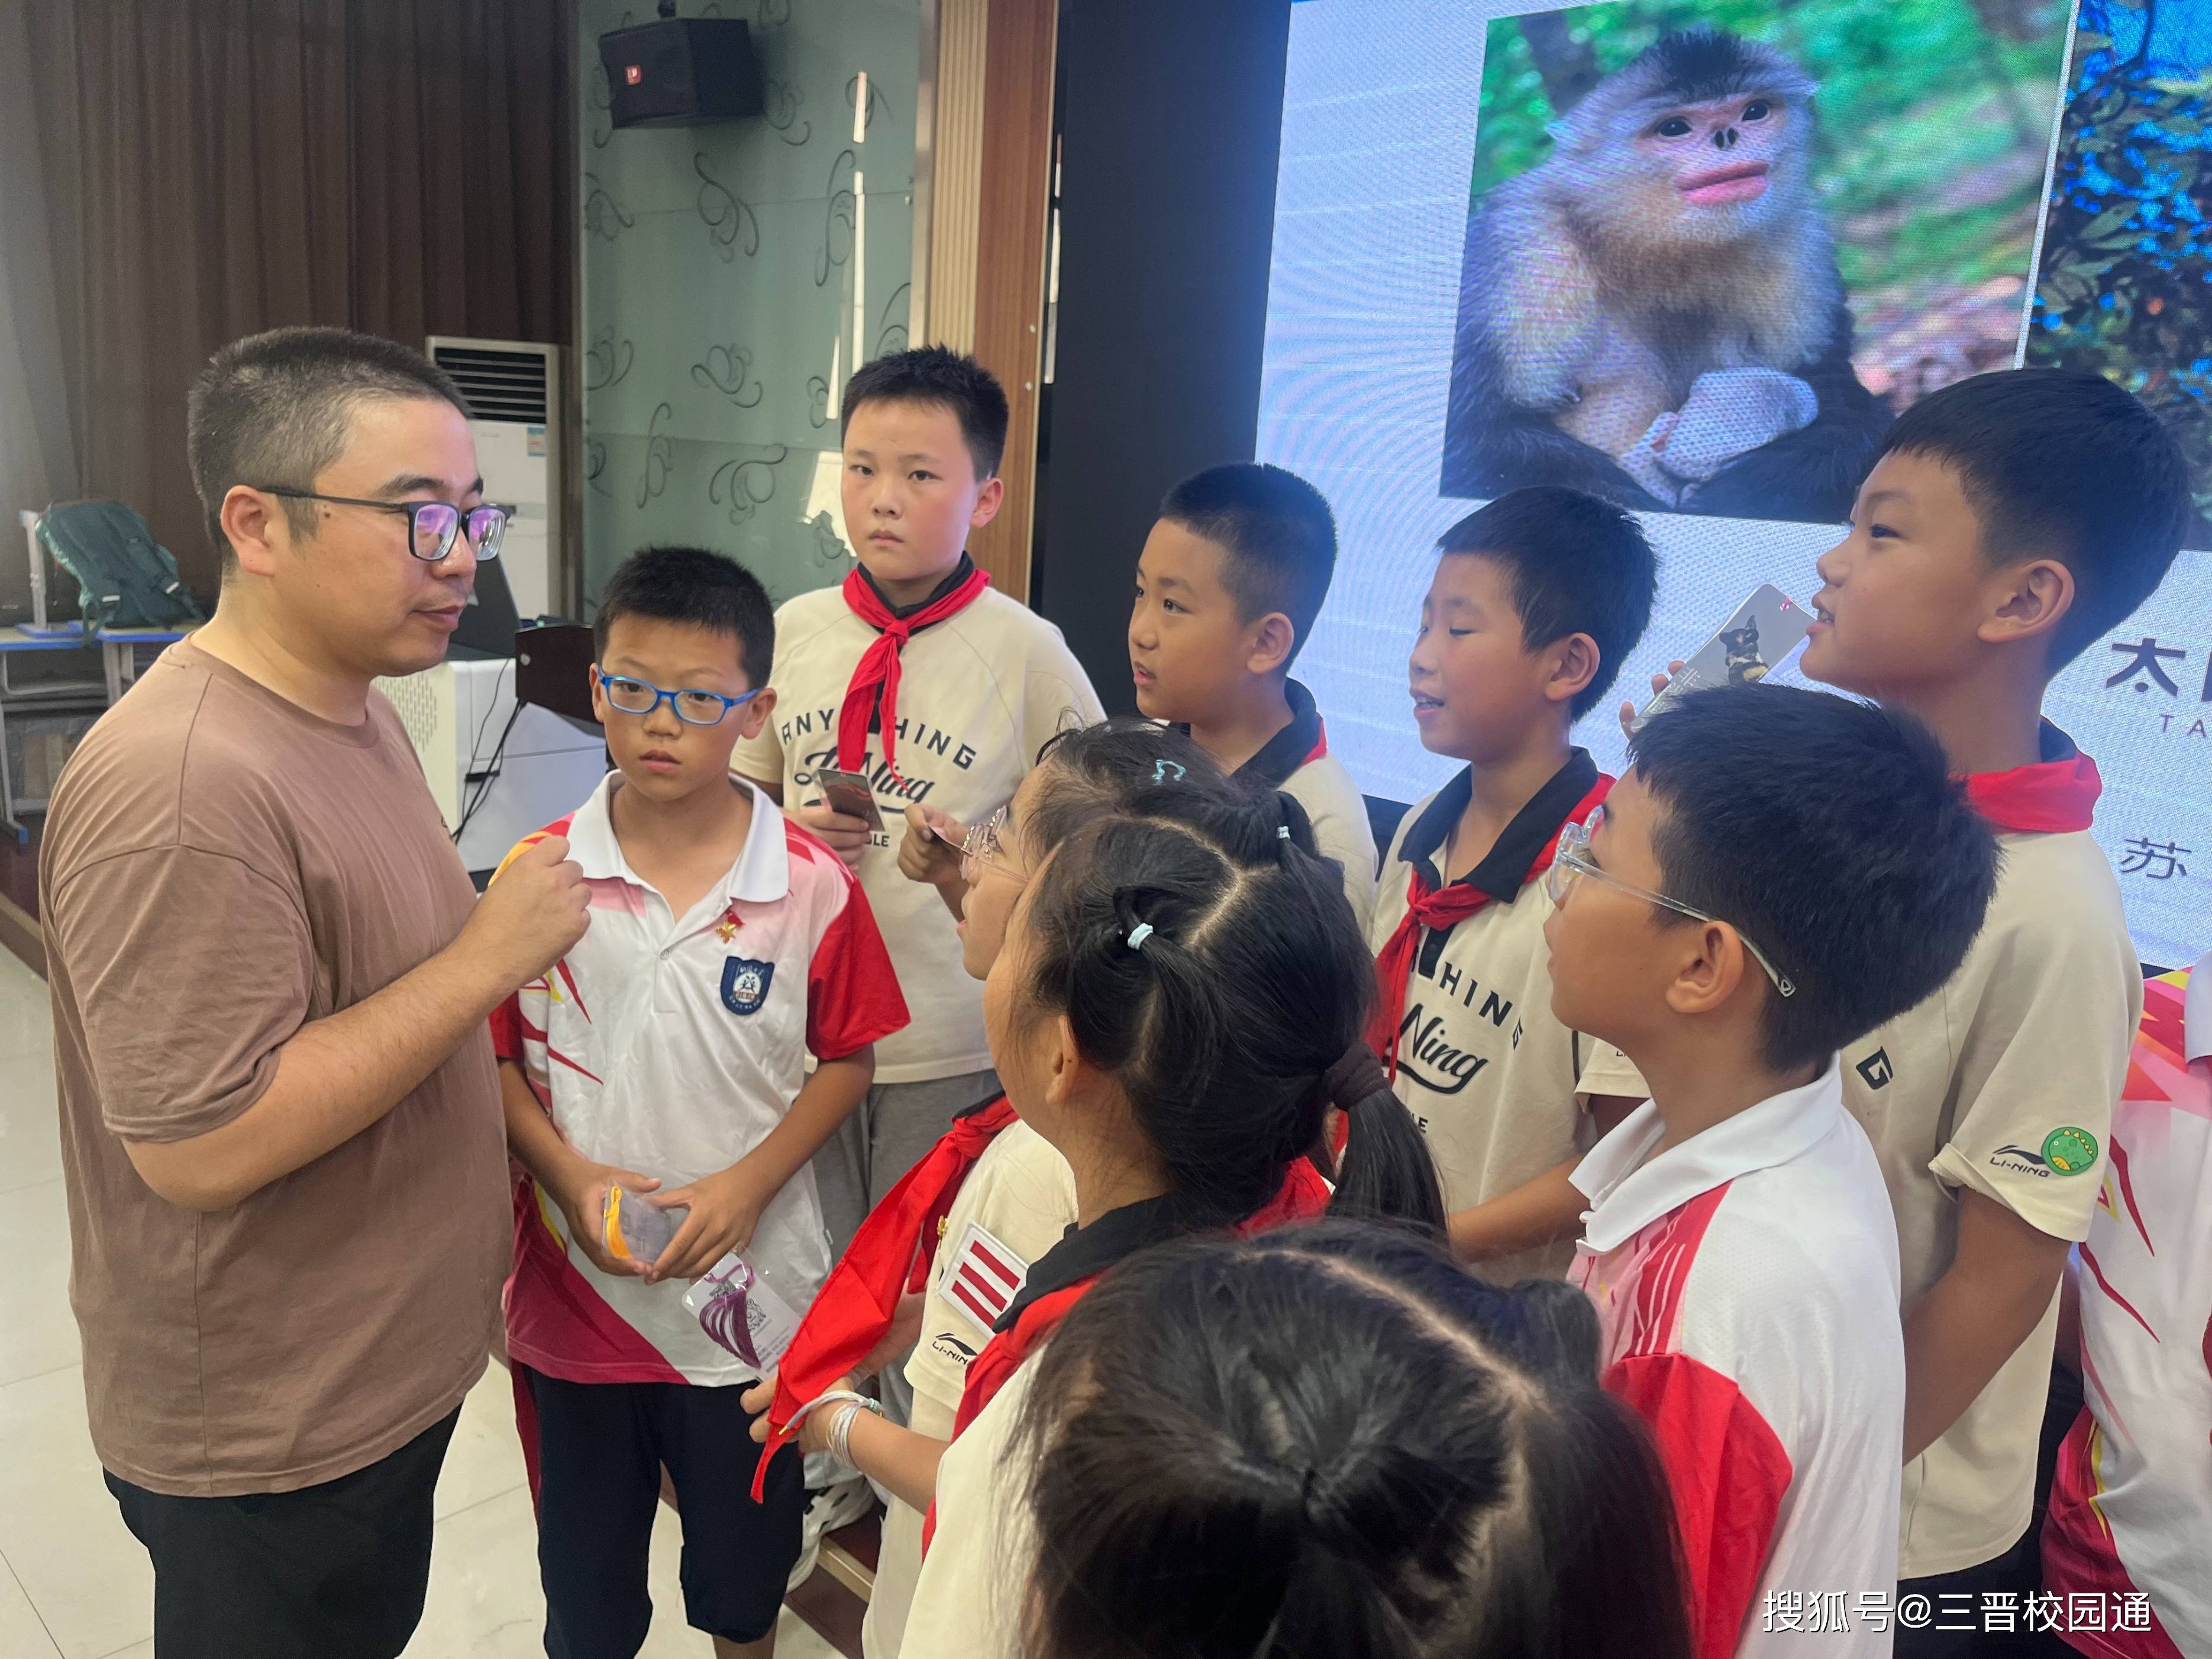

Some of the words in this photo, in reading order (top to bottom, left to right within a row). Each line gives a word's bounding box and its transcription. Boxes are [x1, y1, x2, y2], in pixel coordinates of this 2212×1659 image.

[782, 708, 977, 770] ANYHING
[2121, 836, 2192, 880] 苏
[1399, 1003, 1490, 1095] Ning
[1989, 1157, 2050, 1177] LI-NING
[932, 1341, 968, 1365] LI-NIN
